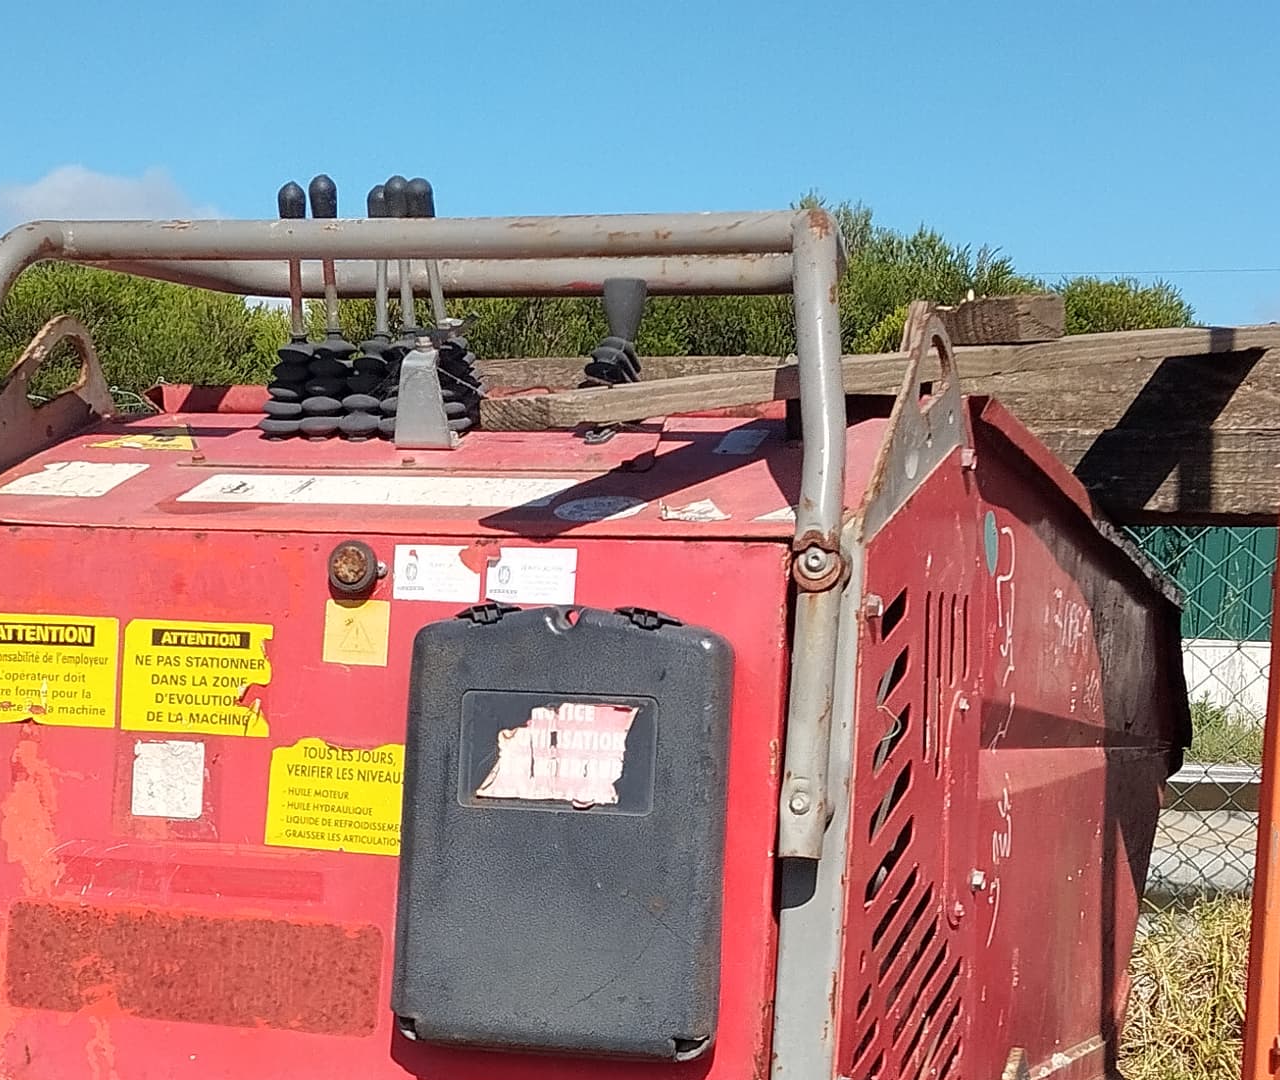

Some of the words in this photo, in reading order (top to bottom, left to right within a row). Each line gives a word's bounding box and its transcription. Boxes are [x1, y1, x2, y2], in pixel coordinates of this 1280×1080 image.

[160, 631, 241, 647] ATTENTION
[42, 652, 53, 663] de
[56, 653, 108, 666] l'employeur
[135, 654, 152, 666] NE
[156, 655, 181, 667] PAS
[185, 656, 265, 670] STATIONNER
[63, 672, 86, 682] doit
[151, 674, 187, 686] DANS
[192, 675, 208, 687] LA
[51, 691, 78, 702] pour
[82, 689, 92, 699] la
[57, 705, 106, 716] machine
[146, 711, 163, 723] DE
[168, 712, 183, 723] LA
[304, 746, 333, 760] TOUS
[336, 749, 354, 762] LES
[356, 751, 396, 766] JOURS,
[287, 764, 333, 779] VERIFIER
[336, 767, 354, 781] LES
[357, 769, 403, 785] NIVEAU
[288, 787, 311, 797] HUILE
[314, 789, 349, 800] MOTEUR
[287, 801, 310, 811] HUILE
[312, 803, 373, 816] HYDRAULIQUE
[286, 815, 319, 826] LIQUIDE
[321, 817, 331, 827] DE
[334, 819, 401, 833] REFROIDISSEME
[285, 829, 324, 841] GRAISSER
[327, 832, 341, 842] LES
